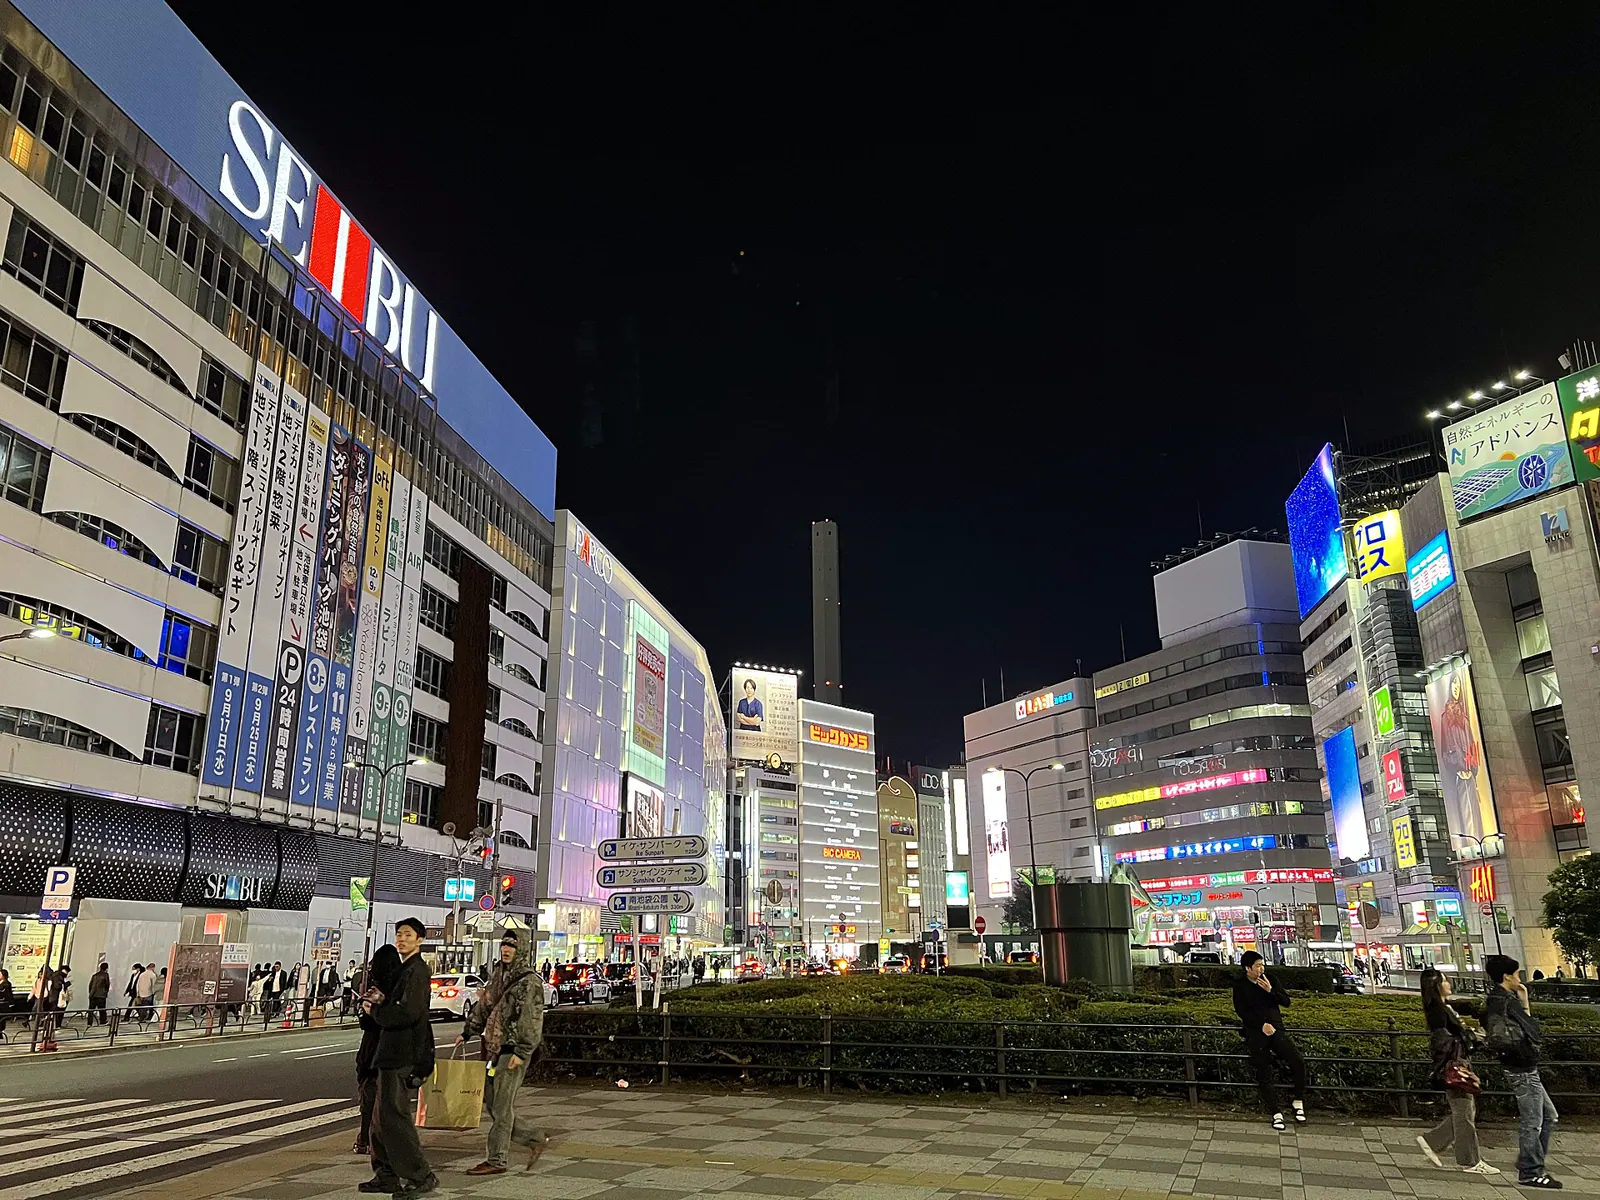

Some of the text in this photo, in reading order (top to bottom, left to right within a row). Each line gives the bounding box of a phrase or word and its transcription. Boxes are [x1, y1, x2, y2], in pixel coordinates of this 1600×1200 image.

[219, 100, 438, 395] SEIBU
[256, 373, 278, 397] SEIBU
[1446, 392, 1554, 446] 自然エネルギーの
[1469, 412, 1559, 459] アドバンス
[1544, 531, 1571, 543] HULIC
[316, 452, 347, 652] ダイニングパーク池袋
[407, 551, 422, 571] AIR
[575, 525, 613, 584] PARCO
[378, 607, 391, 676] ラビータ
[308, 662, 326, 688] 8F
[374, 690, 389, 714] 9F
[394, 697, 408, 722] 9F
[354, 711, 364, 729] 1F
[272, 685, 297, 790] 24時間営業
[299, 695, 319, 796] レストラン
[809, 724, 869, 750] ビックカメラ
[835, 848, 861, 860] CAMERA
[50, 870, 70, 892] P
[618, 867, 682, 878] サンシャインシティ
[632, 876, 655, 884] Sunshine
[656, 876, 667, 884] City
[204, 872, 264, 902] SEIBU
